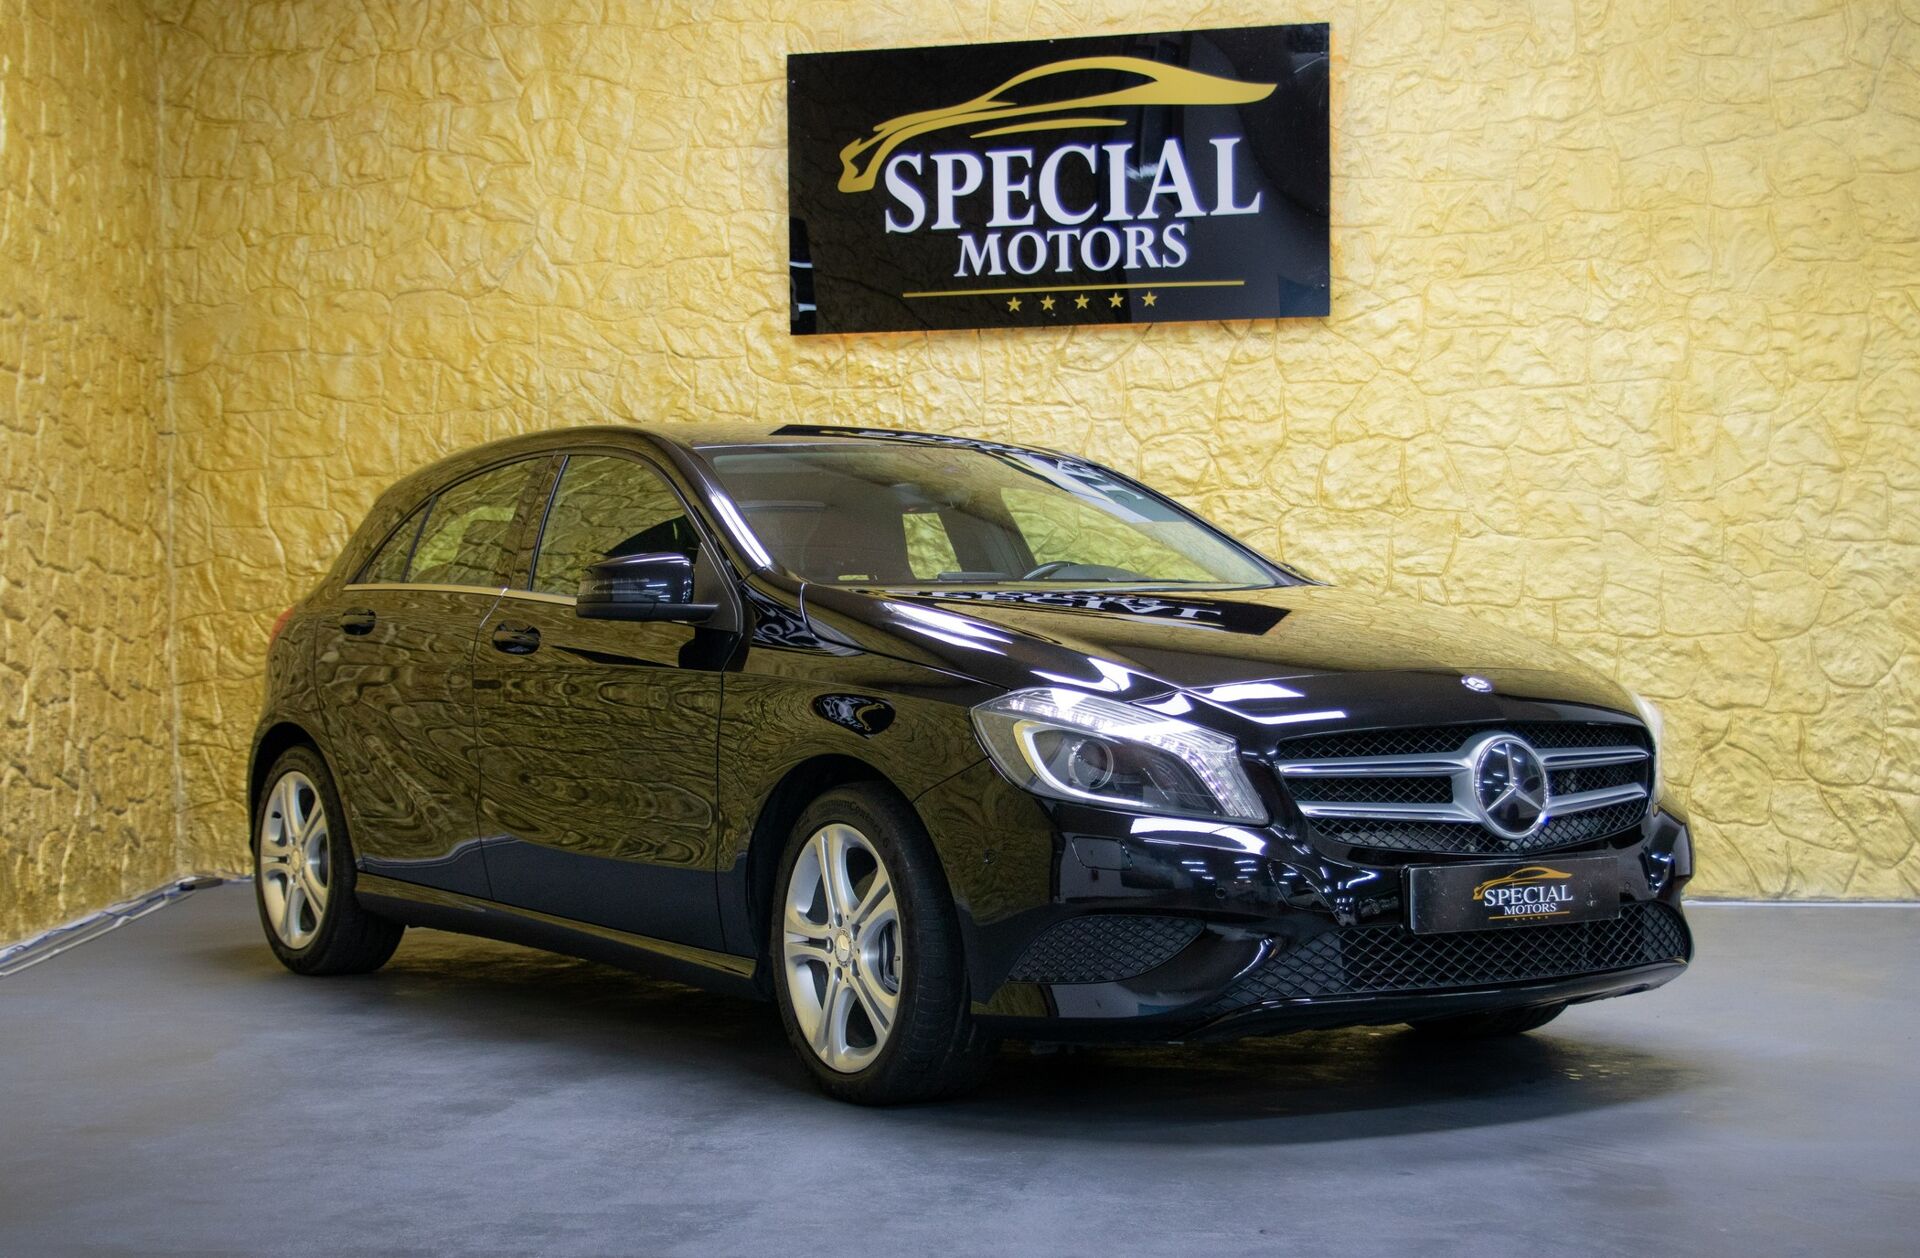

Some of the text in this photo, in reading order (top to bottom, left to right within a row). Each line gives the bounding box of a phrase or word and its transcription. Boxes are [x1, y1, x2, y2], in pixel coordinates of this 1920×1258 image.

[885, 137, 1261, 233] SPECIAL
[953, 223, 1188, 277] MOTORS
[1483, 884, 1574, 907] SPECIAL
[1504, 902, 1557, 916] MOTORS
